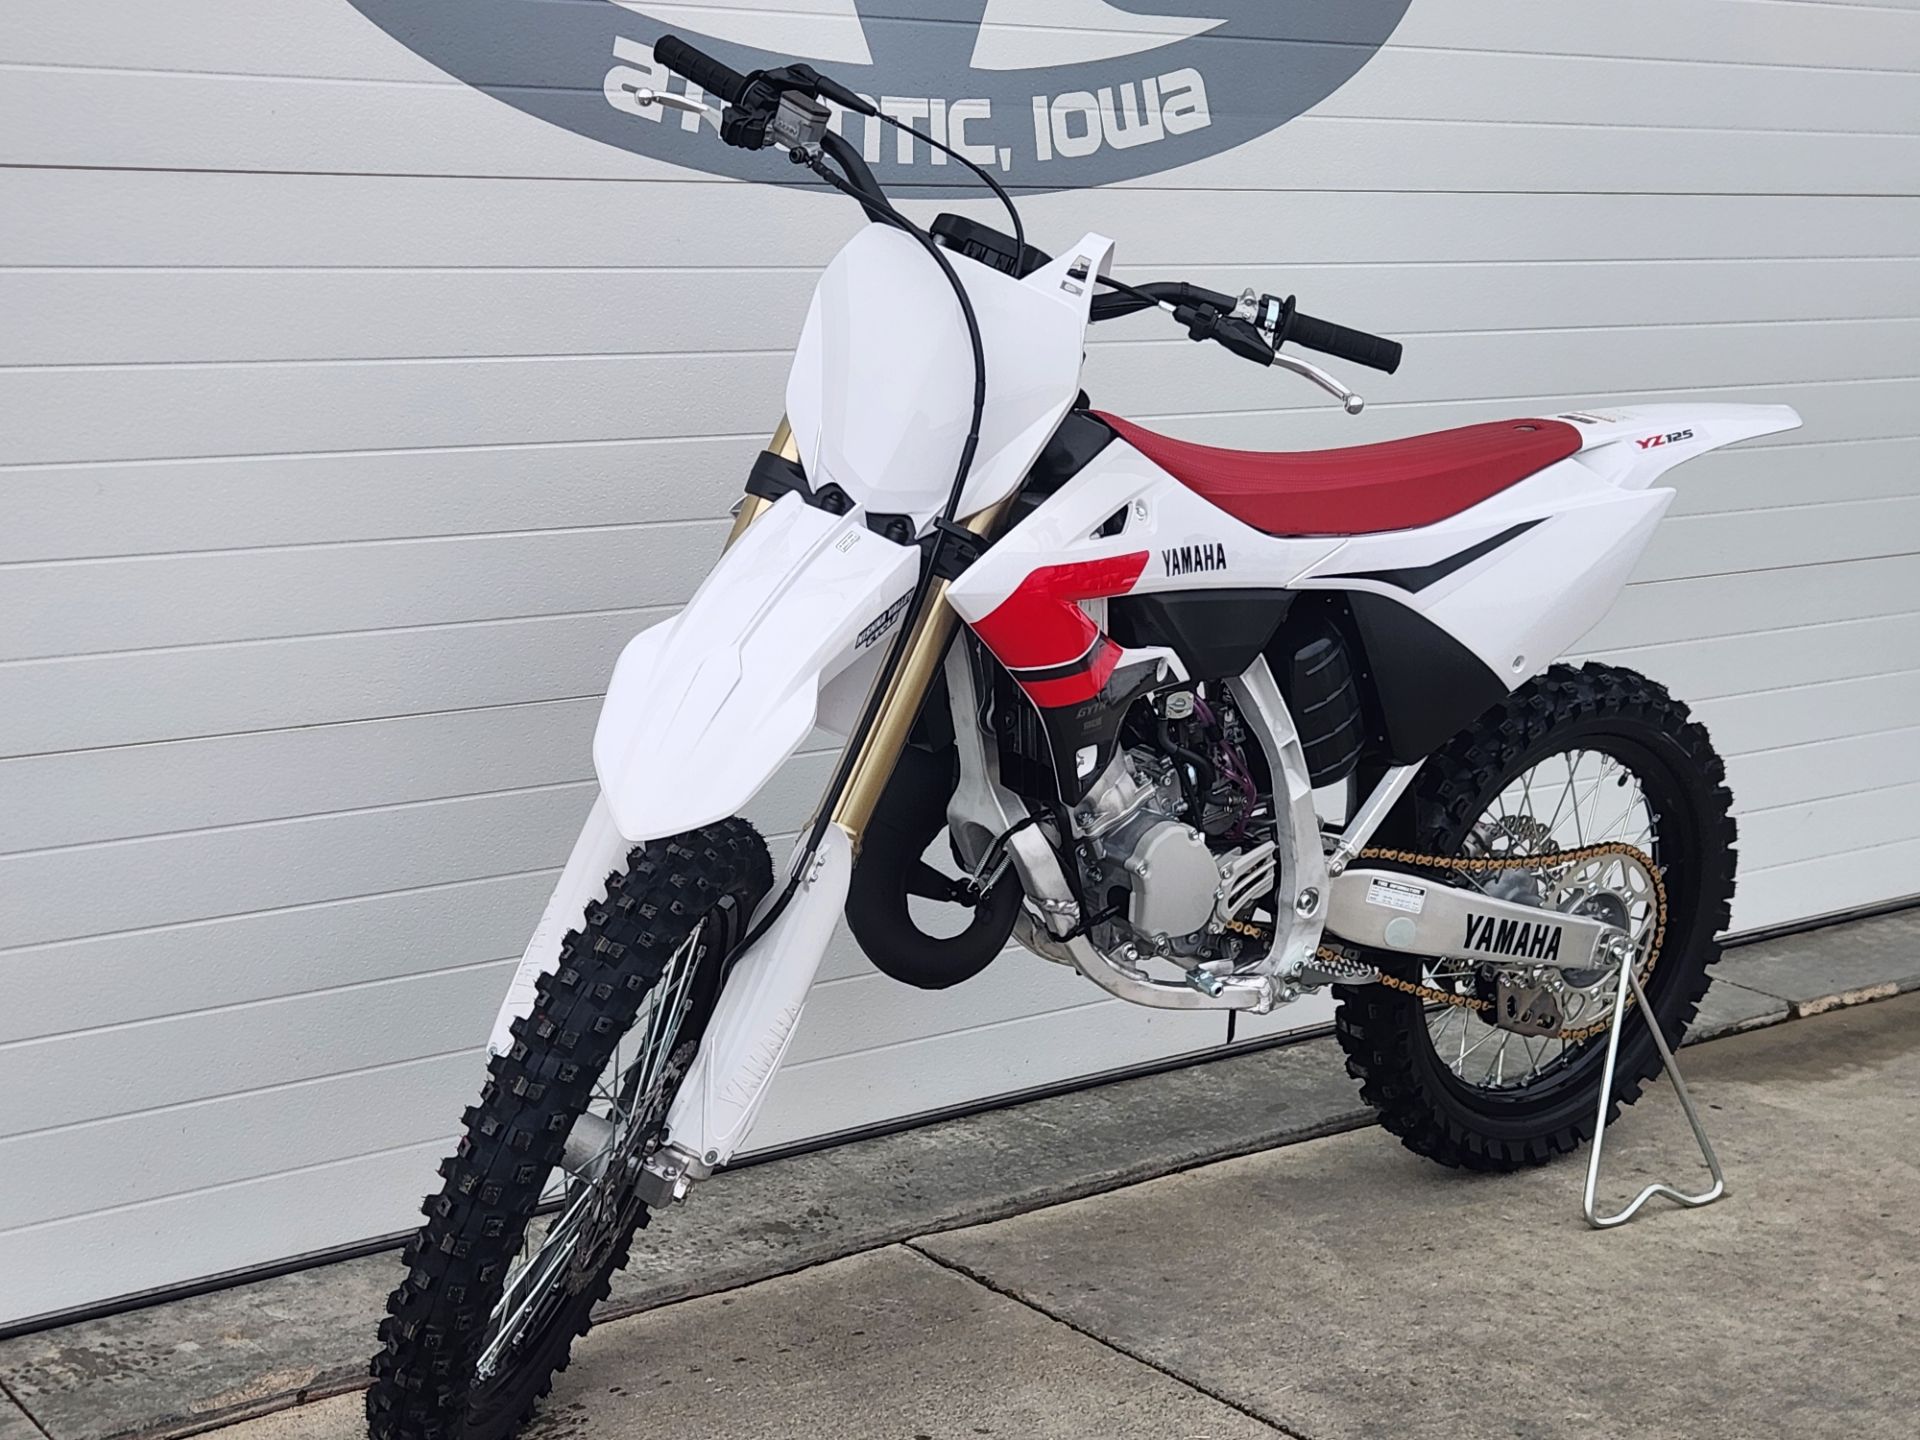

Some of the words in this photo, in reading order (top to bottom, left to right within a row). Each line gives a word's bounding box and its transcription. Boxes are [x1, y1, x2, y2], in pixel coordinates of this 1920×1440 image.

[1635, 428, 1694, 450] YZ125
[1161, 542, 1227, 577] YAMAHA
[1463, 913, 1563, 961] YAMAHA
